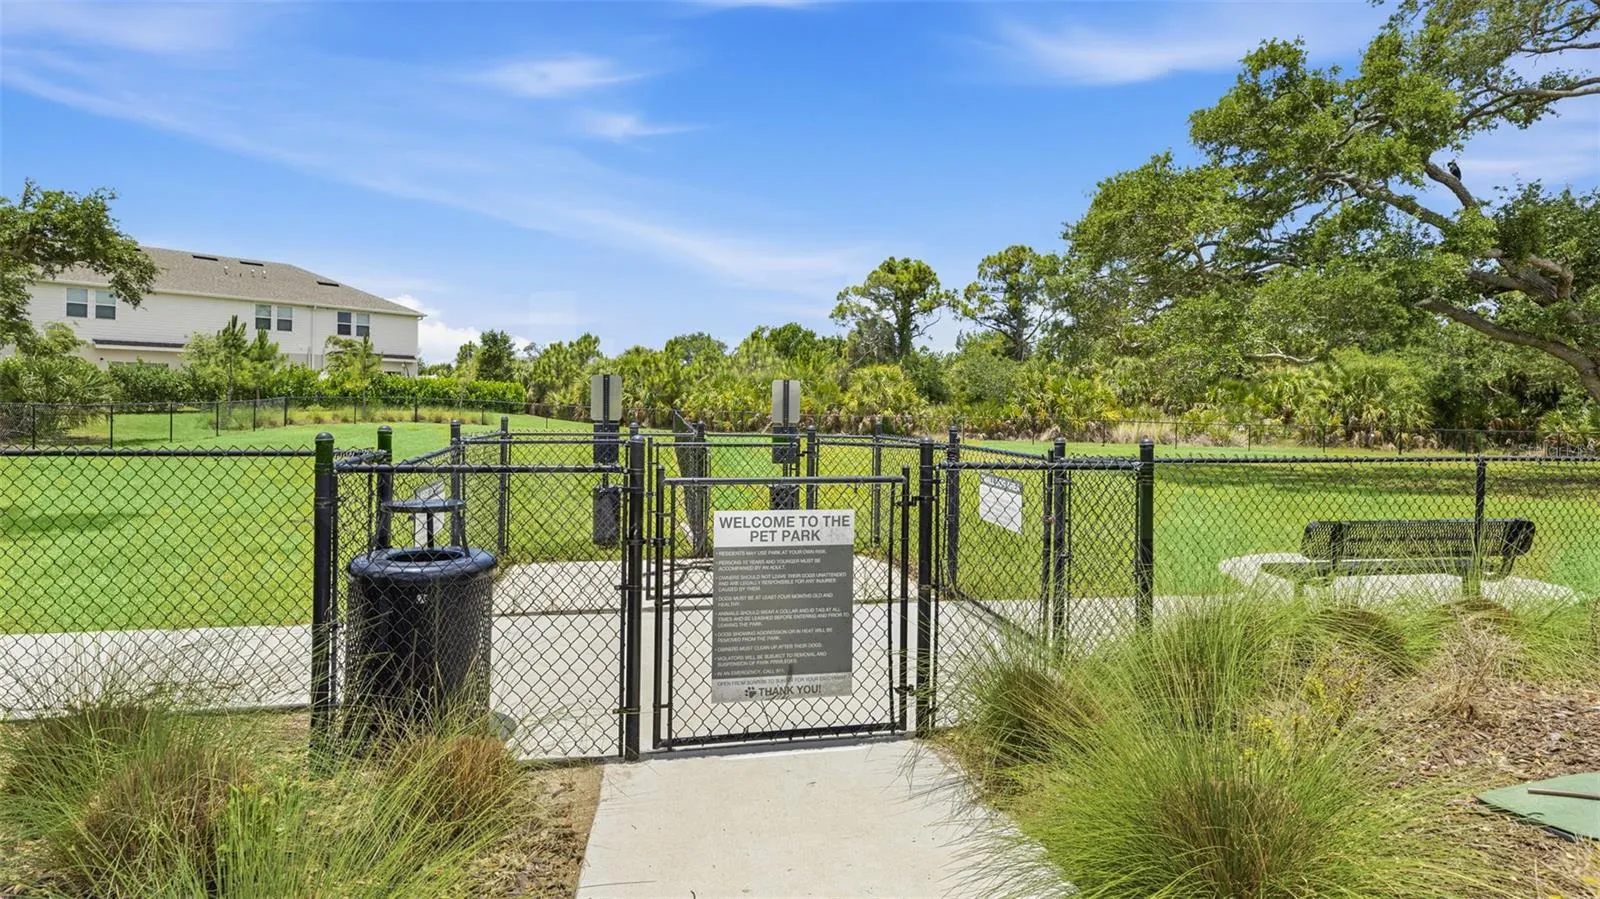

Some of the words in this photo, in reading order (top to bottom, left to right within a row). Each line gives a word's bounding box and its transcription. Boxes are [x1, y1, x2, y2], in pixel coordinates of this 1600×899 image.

[719, 516, 795, 529] WELCOME
[798, 515, 819, 528] TO
[822, 515, 850, 527] THE
[750, 530, 777, 543] PET
[781, 529, 821, 542] PARK
[758, 685, 794, 697] THANK
[797, 684, 822, 694] YOU!
